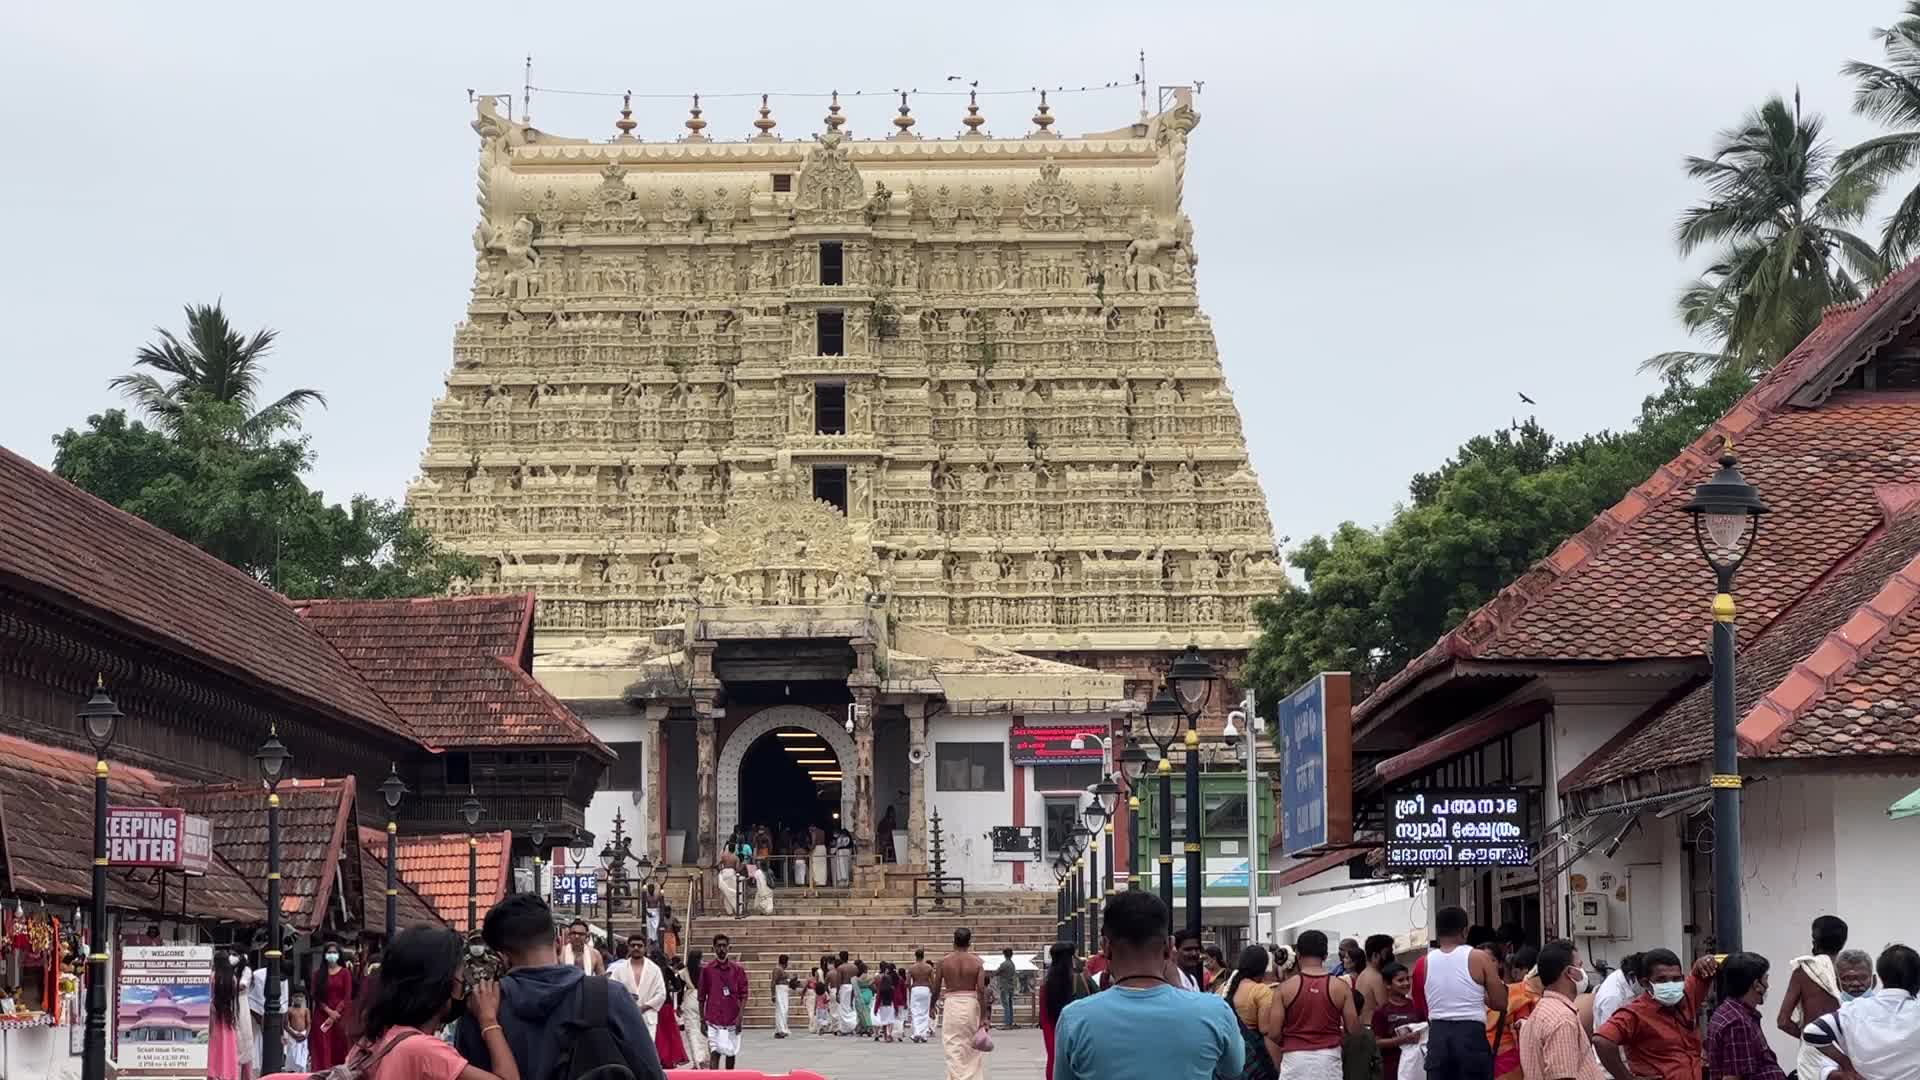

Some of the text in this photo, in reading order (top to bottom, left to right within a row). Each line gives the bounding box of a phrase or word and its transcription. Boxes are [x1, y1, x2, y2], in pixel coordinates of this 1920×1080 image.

[1395, 794, 1425, 819] ശ്രീ
[1395, 817, 1447, 841] സ്വാമി
[176, 976, 210, 984] MUSEUM
